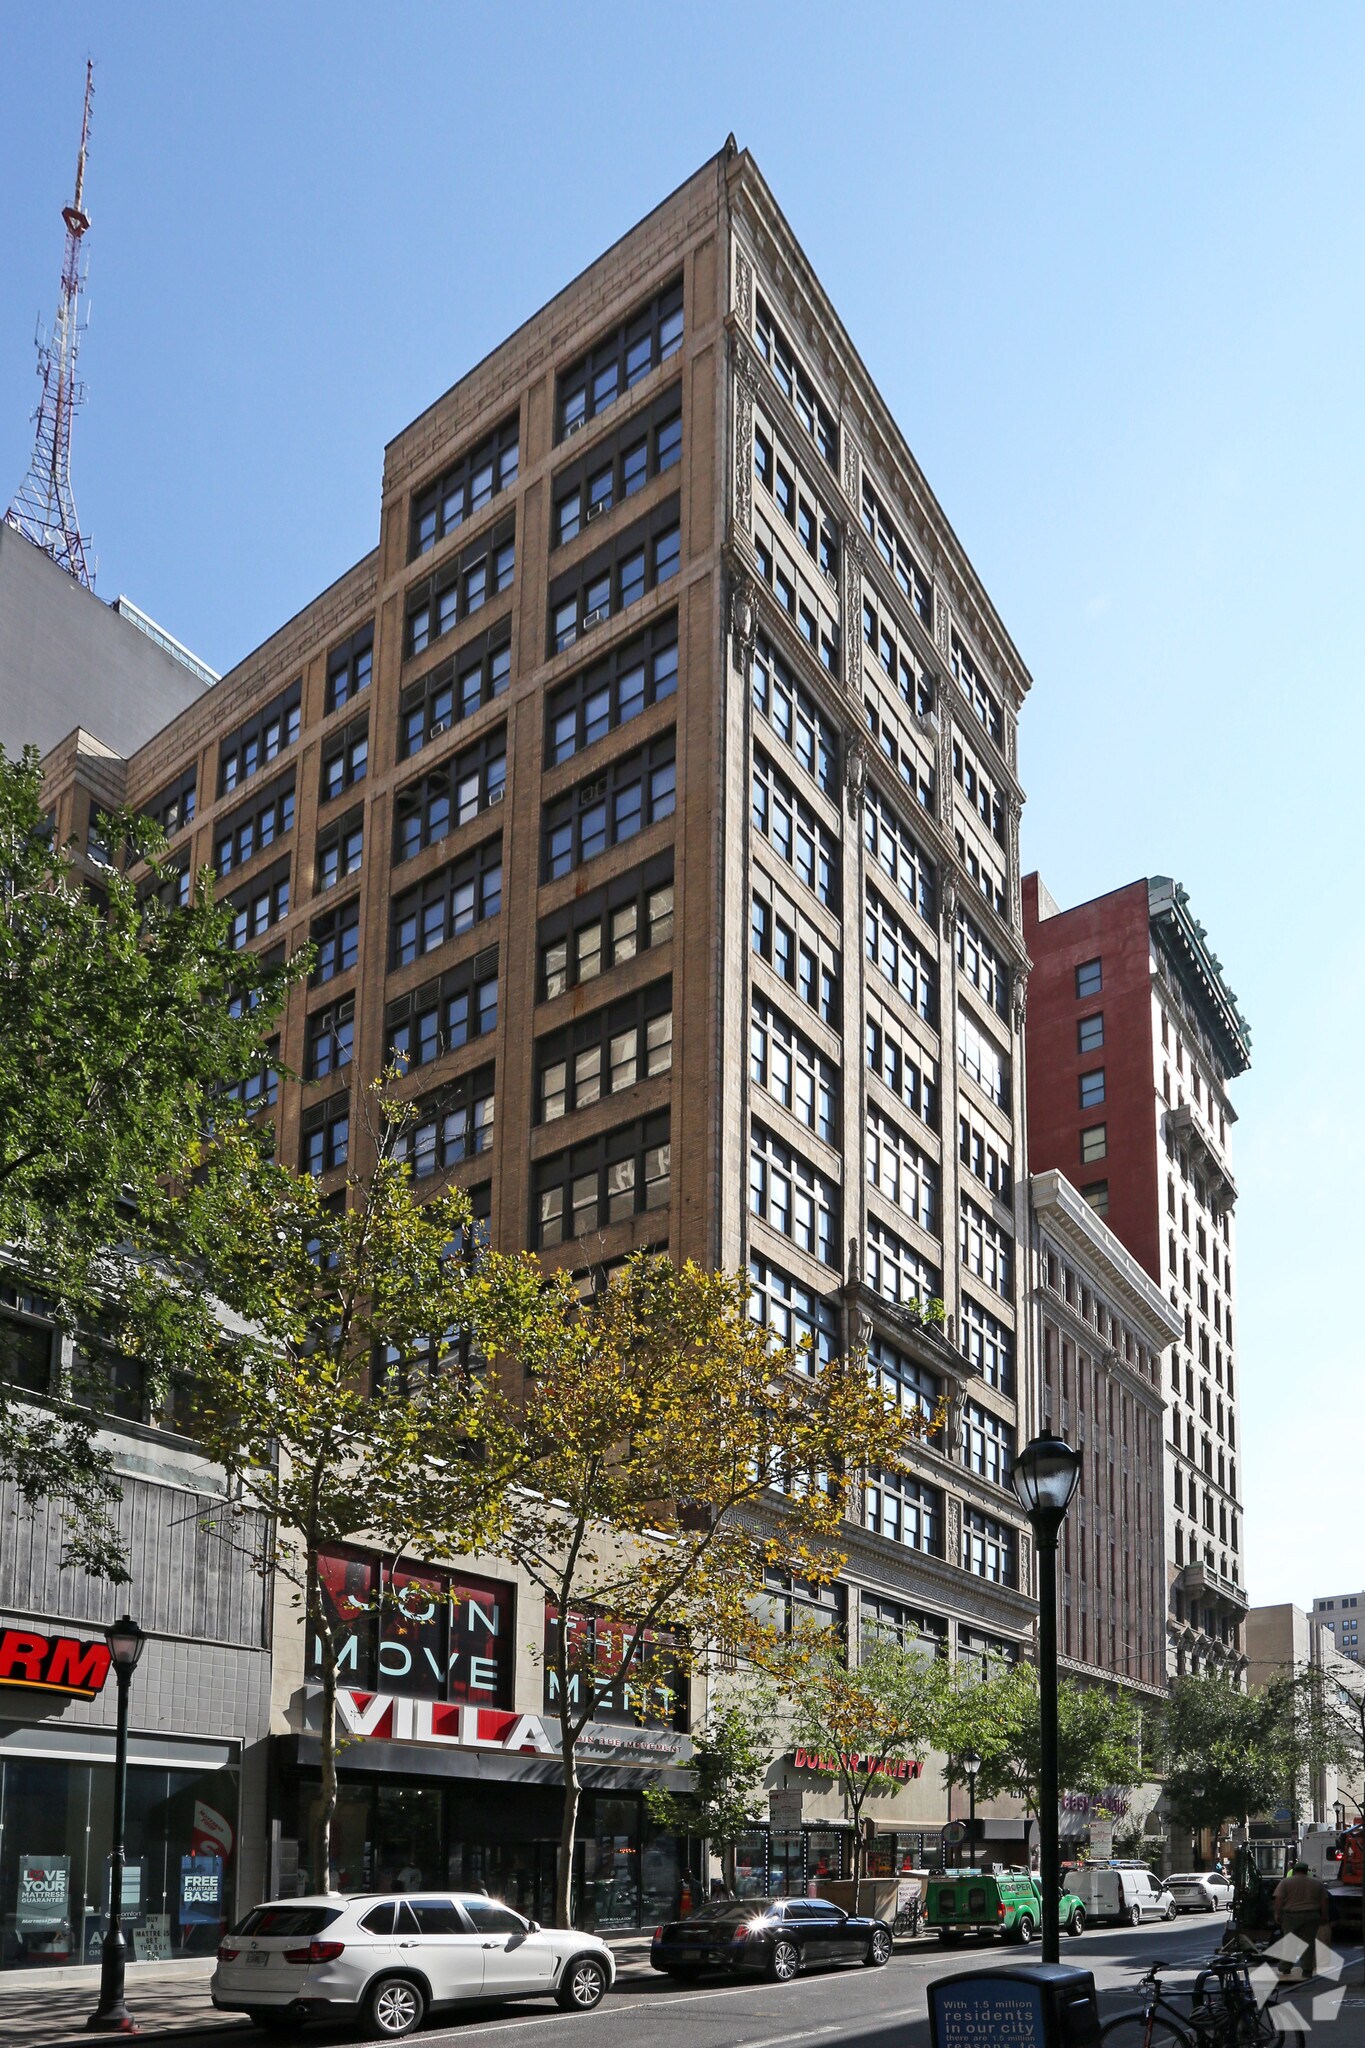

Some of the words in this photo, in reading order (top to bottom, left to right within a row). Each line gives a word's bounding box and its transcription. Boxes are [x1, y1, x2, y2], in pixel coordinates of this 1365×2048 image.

[314, 1634, 497, 1690] MOVE
[335, 1689, 554, 1754] VILLA
[627, 1741, 682, 1753] MOVEMENT
[795, 1748, 860, 1774] DOLLAR
[867, 1755, 924, 1778] VARIETY
[23, 1881, 65, 1891] YOUR
[185, 1876, 218, 1887] FREE
[1001, 1883, 1031, 1892] COOPER
[184, 1892, 218, 1902] BASE
[943, 2001, 967, 2009] With
[974, 2001, 989, 2009] 1.5
[945, 2010, 1034, 2021] residents
[946, 2022, 960, 2033] in
[966, 2024, 995, 2033] our
[1001, 2022, 1034, 2036] city
